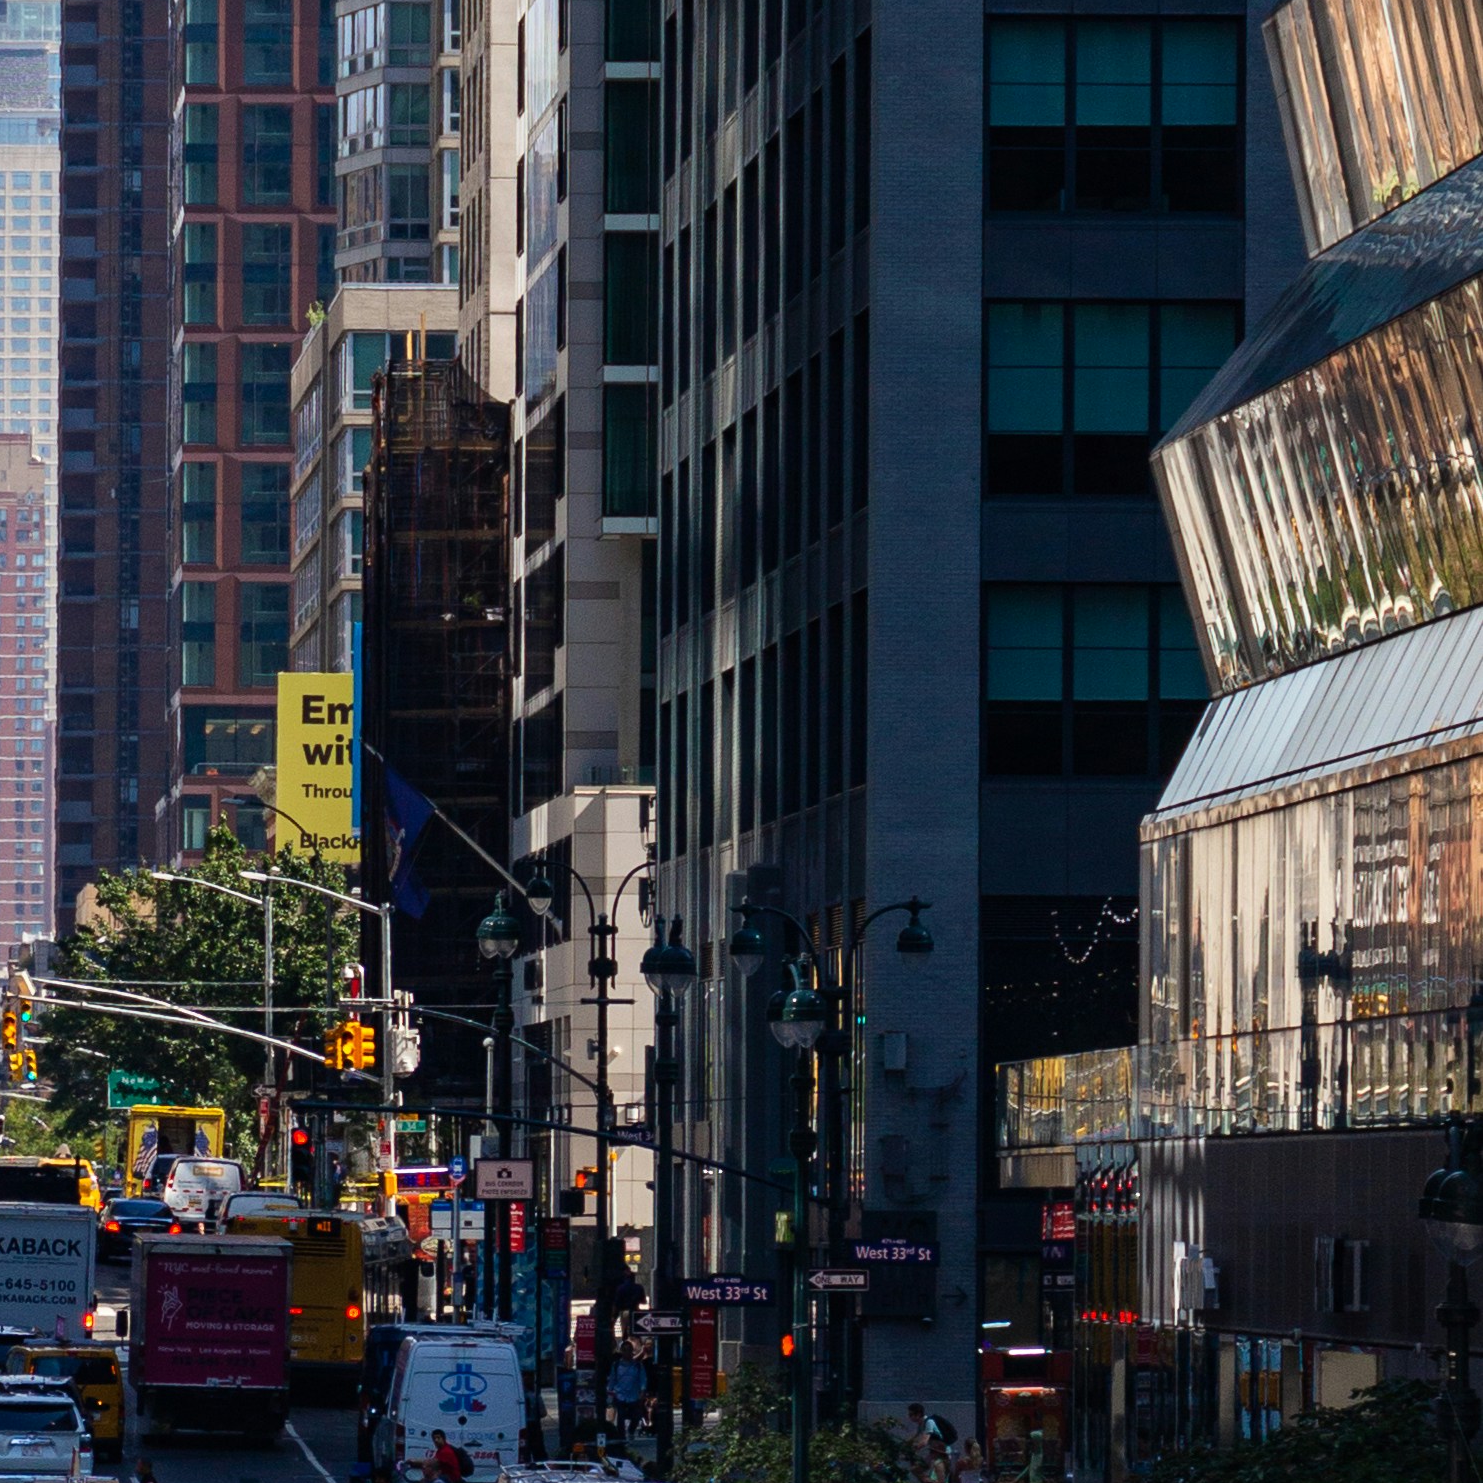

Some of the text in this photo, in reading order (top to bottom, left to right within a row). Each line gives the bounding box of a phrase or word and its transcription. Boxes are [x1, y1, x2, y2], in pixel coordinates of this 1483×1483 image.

[855, 1246, 932, 1261] West 33rd St
[816, 1276, 859, 1285] ONE WAY
[687, 1286, 769, 1300] West 33rd St
[186, 1322, 275, 1332] MOVING & STORAGE
[643, 1317, 659, 1327] ONE
